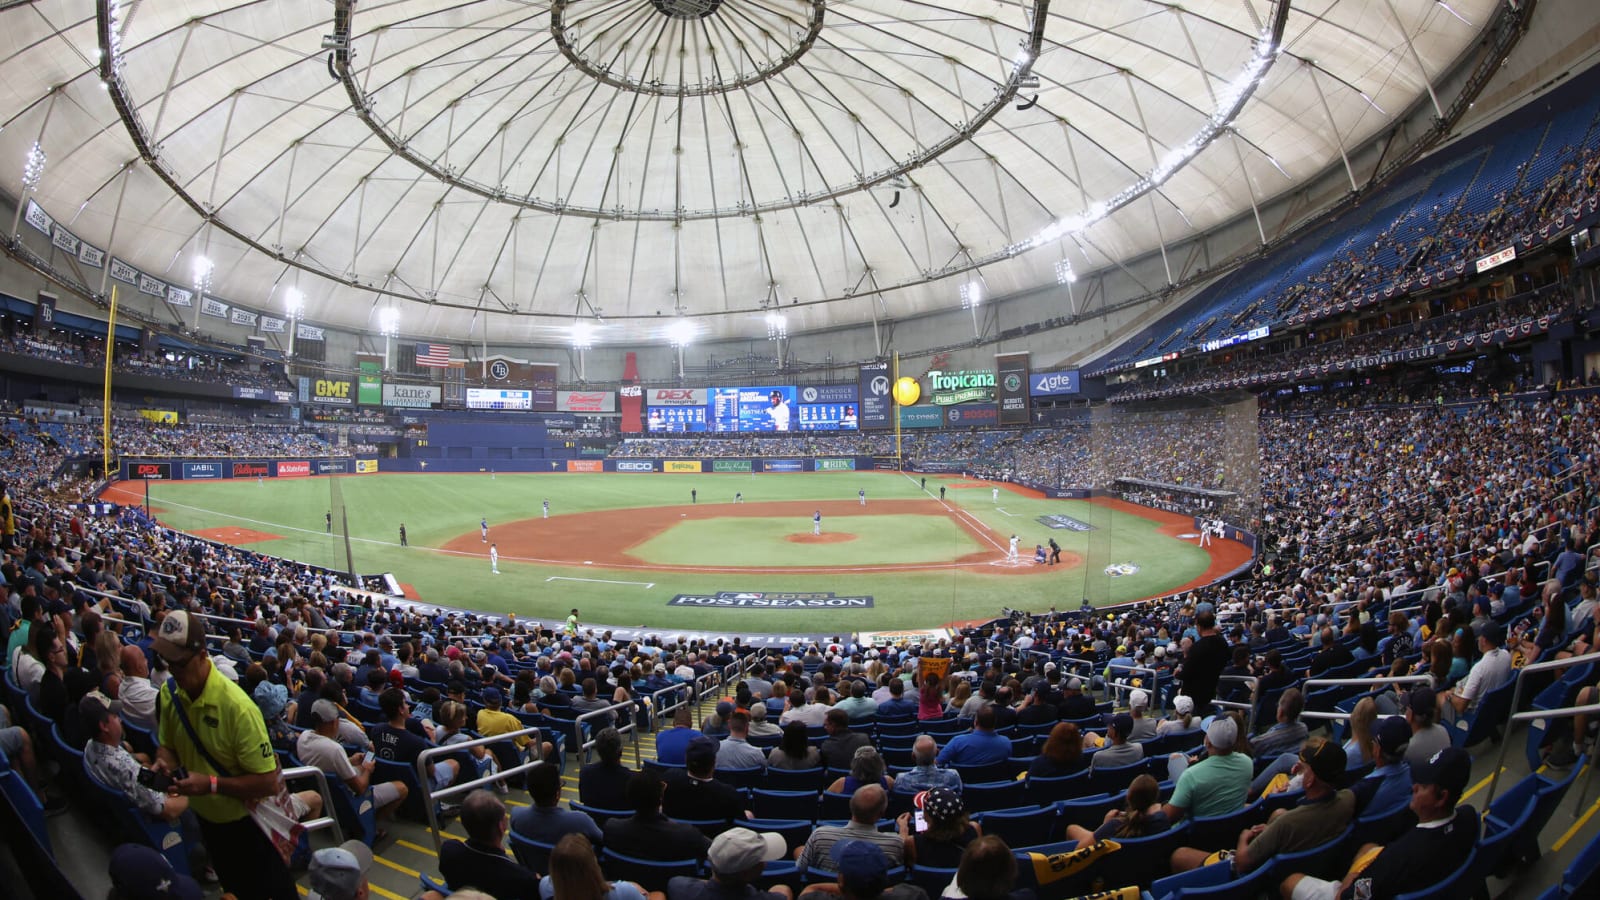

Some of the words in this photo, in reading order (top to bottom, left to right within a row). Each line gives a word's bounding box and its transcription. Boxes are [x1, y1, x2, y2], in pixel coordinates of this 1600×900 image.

[117, 266, 131, 277] 2011
[1350, 354, 1404, 369] AEROVANTI
[1409, 348, 1435, 359] CLUB
[928, 370, 995, 390] Tropicana
[1049, 375, 1070, 387] gte
[315, 379, 351, 397] GMF
[656, 390, 694, 400] DEX
[936, 394, 954, 403] PURE
[955, 390, 986, 401] PREMIUM
[963, 410, 997, 419] BOSCH
[618, 462, 652, 470] GEICO
[830, 460, 848, 468] RIPA
[138, 465, 160, 474] DEX
[676, 596, 867, 606] POSTSEASON
[746, 635, 843, 645] FIELD
